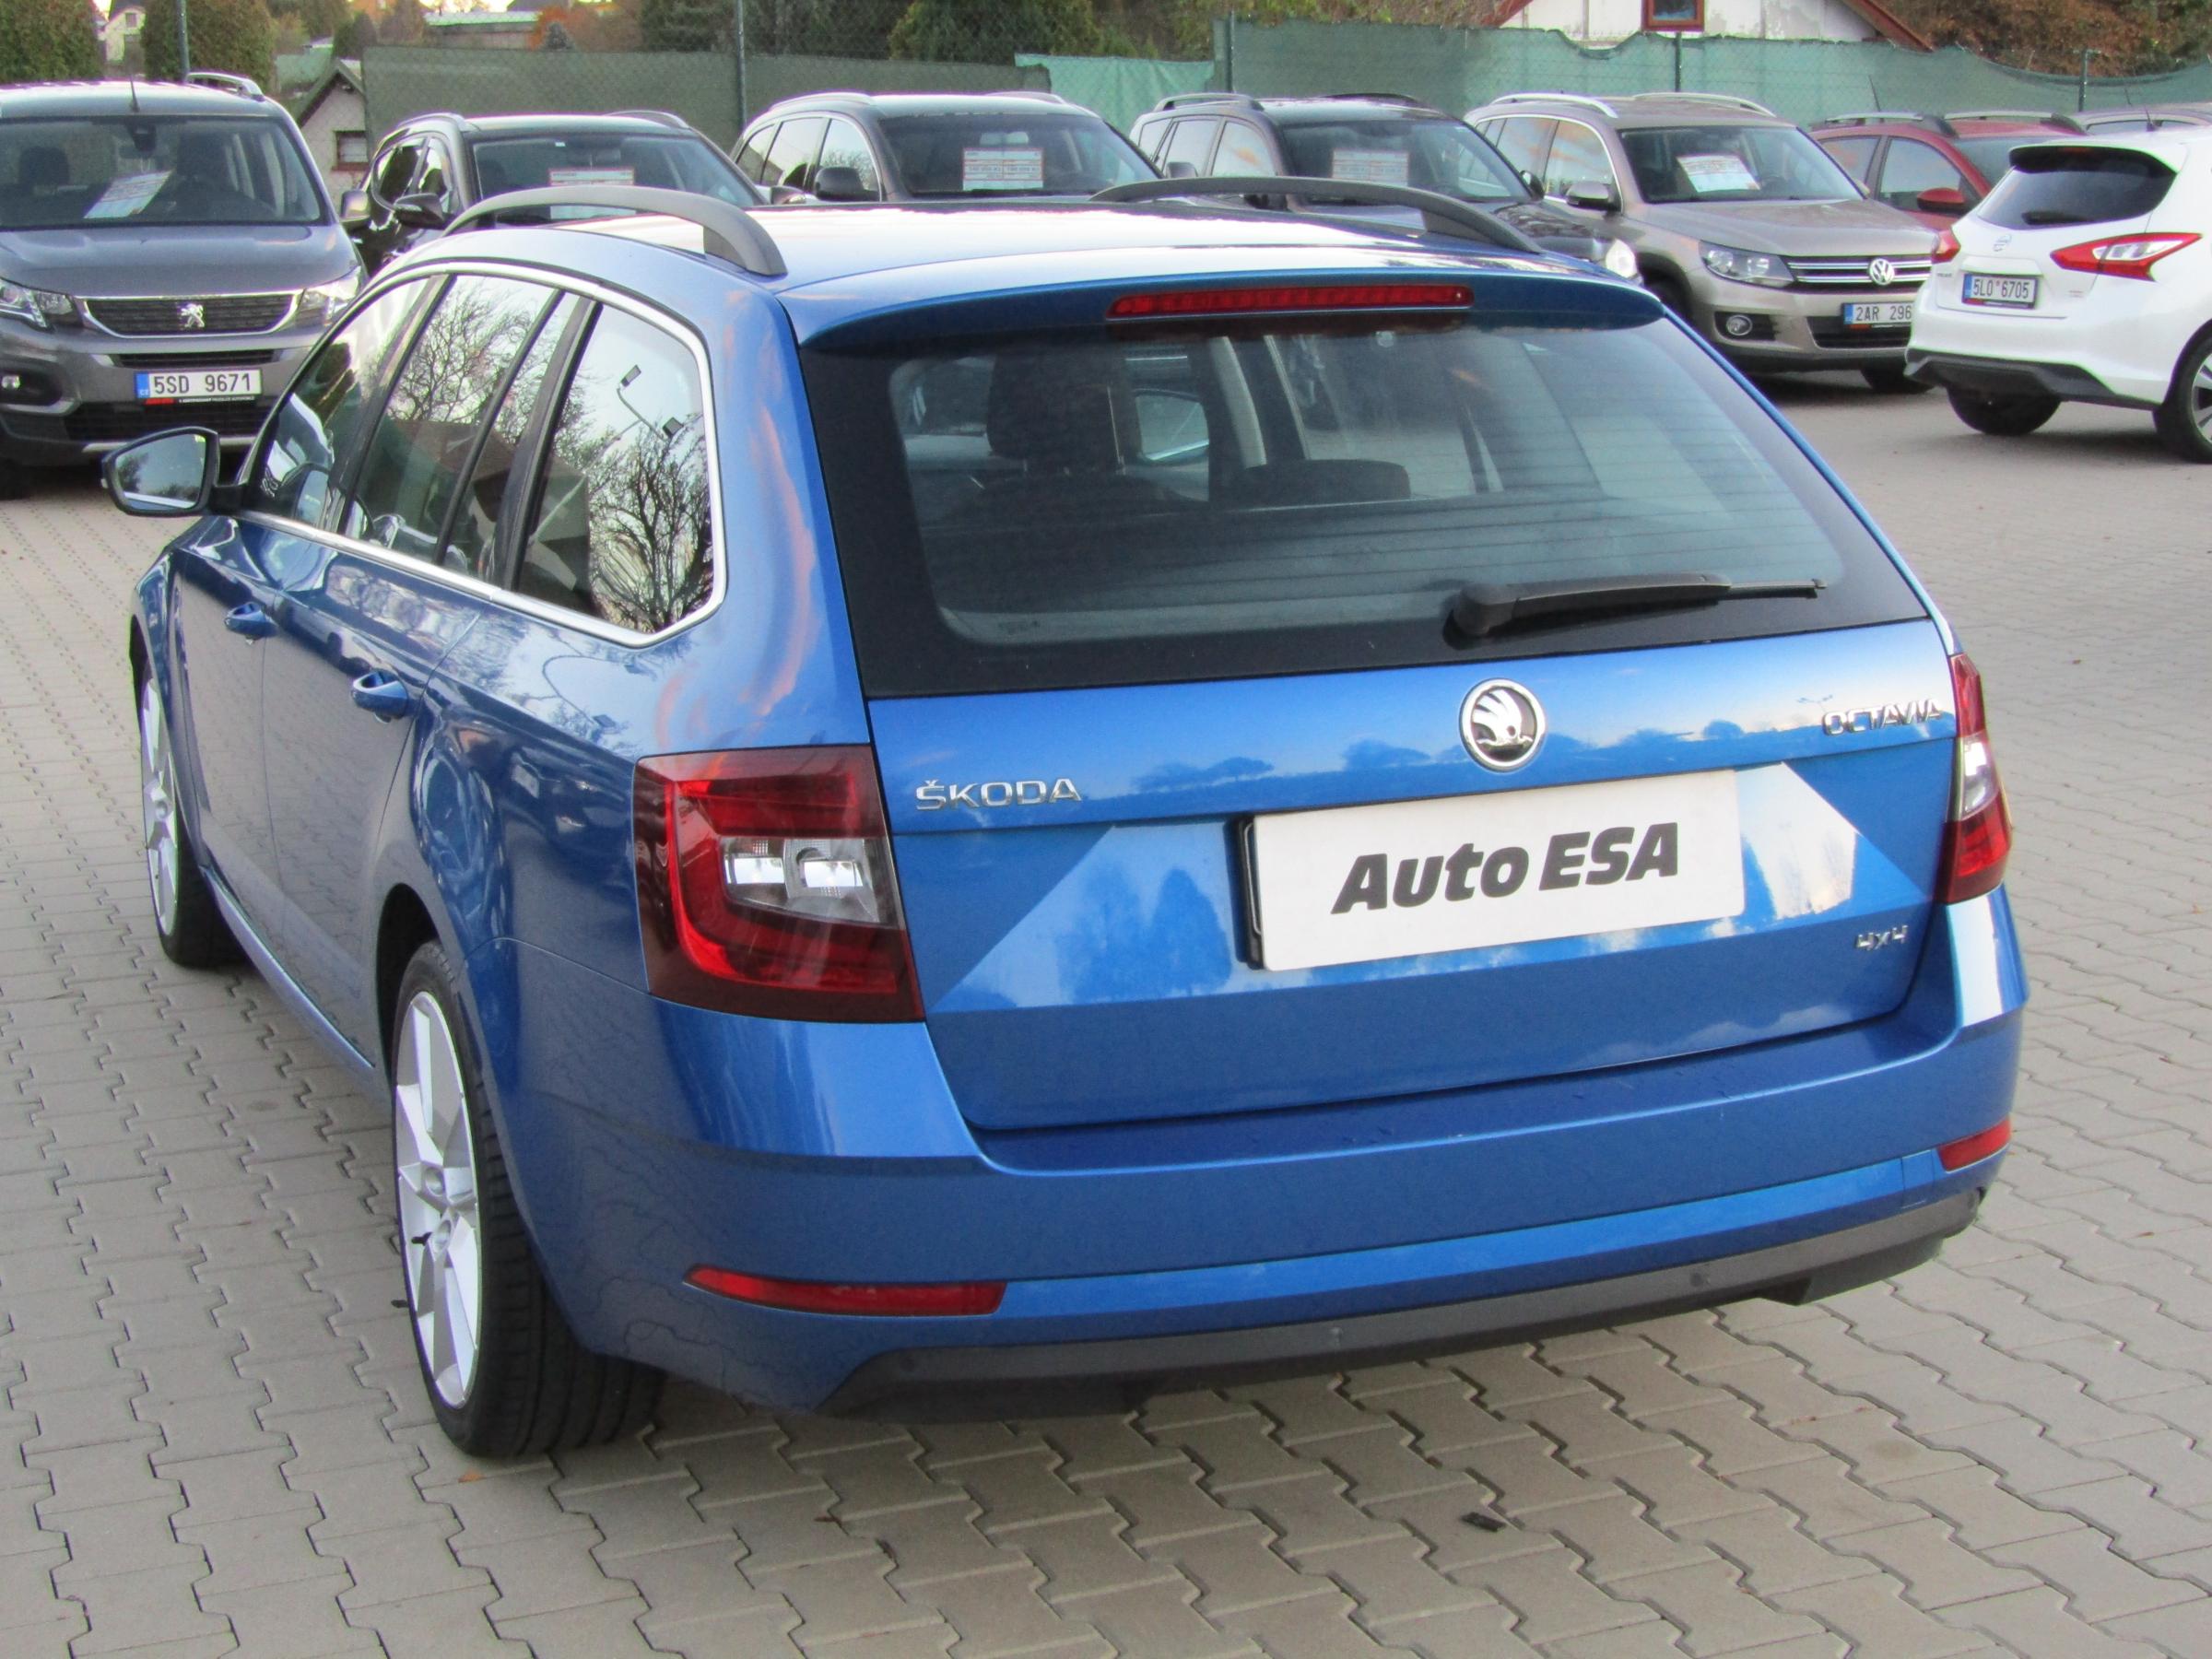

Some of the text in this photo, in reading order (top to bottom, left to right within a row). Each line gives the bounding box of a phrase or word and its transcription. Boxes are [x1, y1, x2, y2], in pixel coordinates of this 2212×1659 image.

[2001, 280, 2030, 300] 6705
[1855, 305, 1912, 322] 2AR 296
[153, 372, 251, 394] 5SD 9671
[1822, 699, 1942, 735] OCTAVIA
[915, 778, 1082, 810] ŠKODA
[1330, 822, 1678, 915] Auto ESA
[1855, 924, 1909, 950] 4x4
